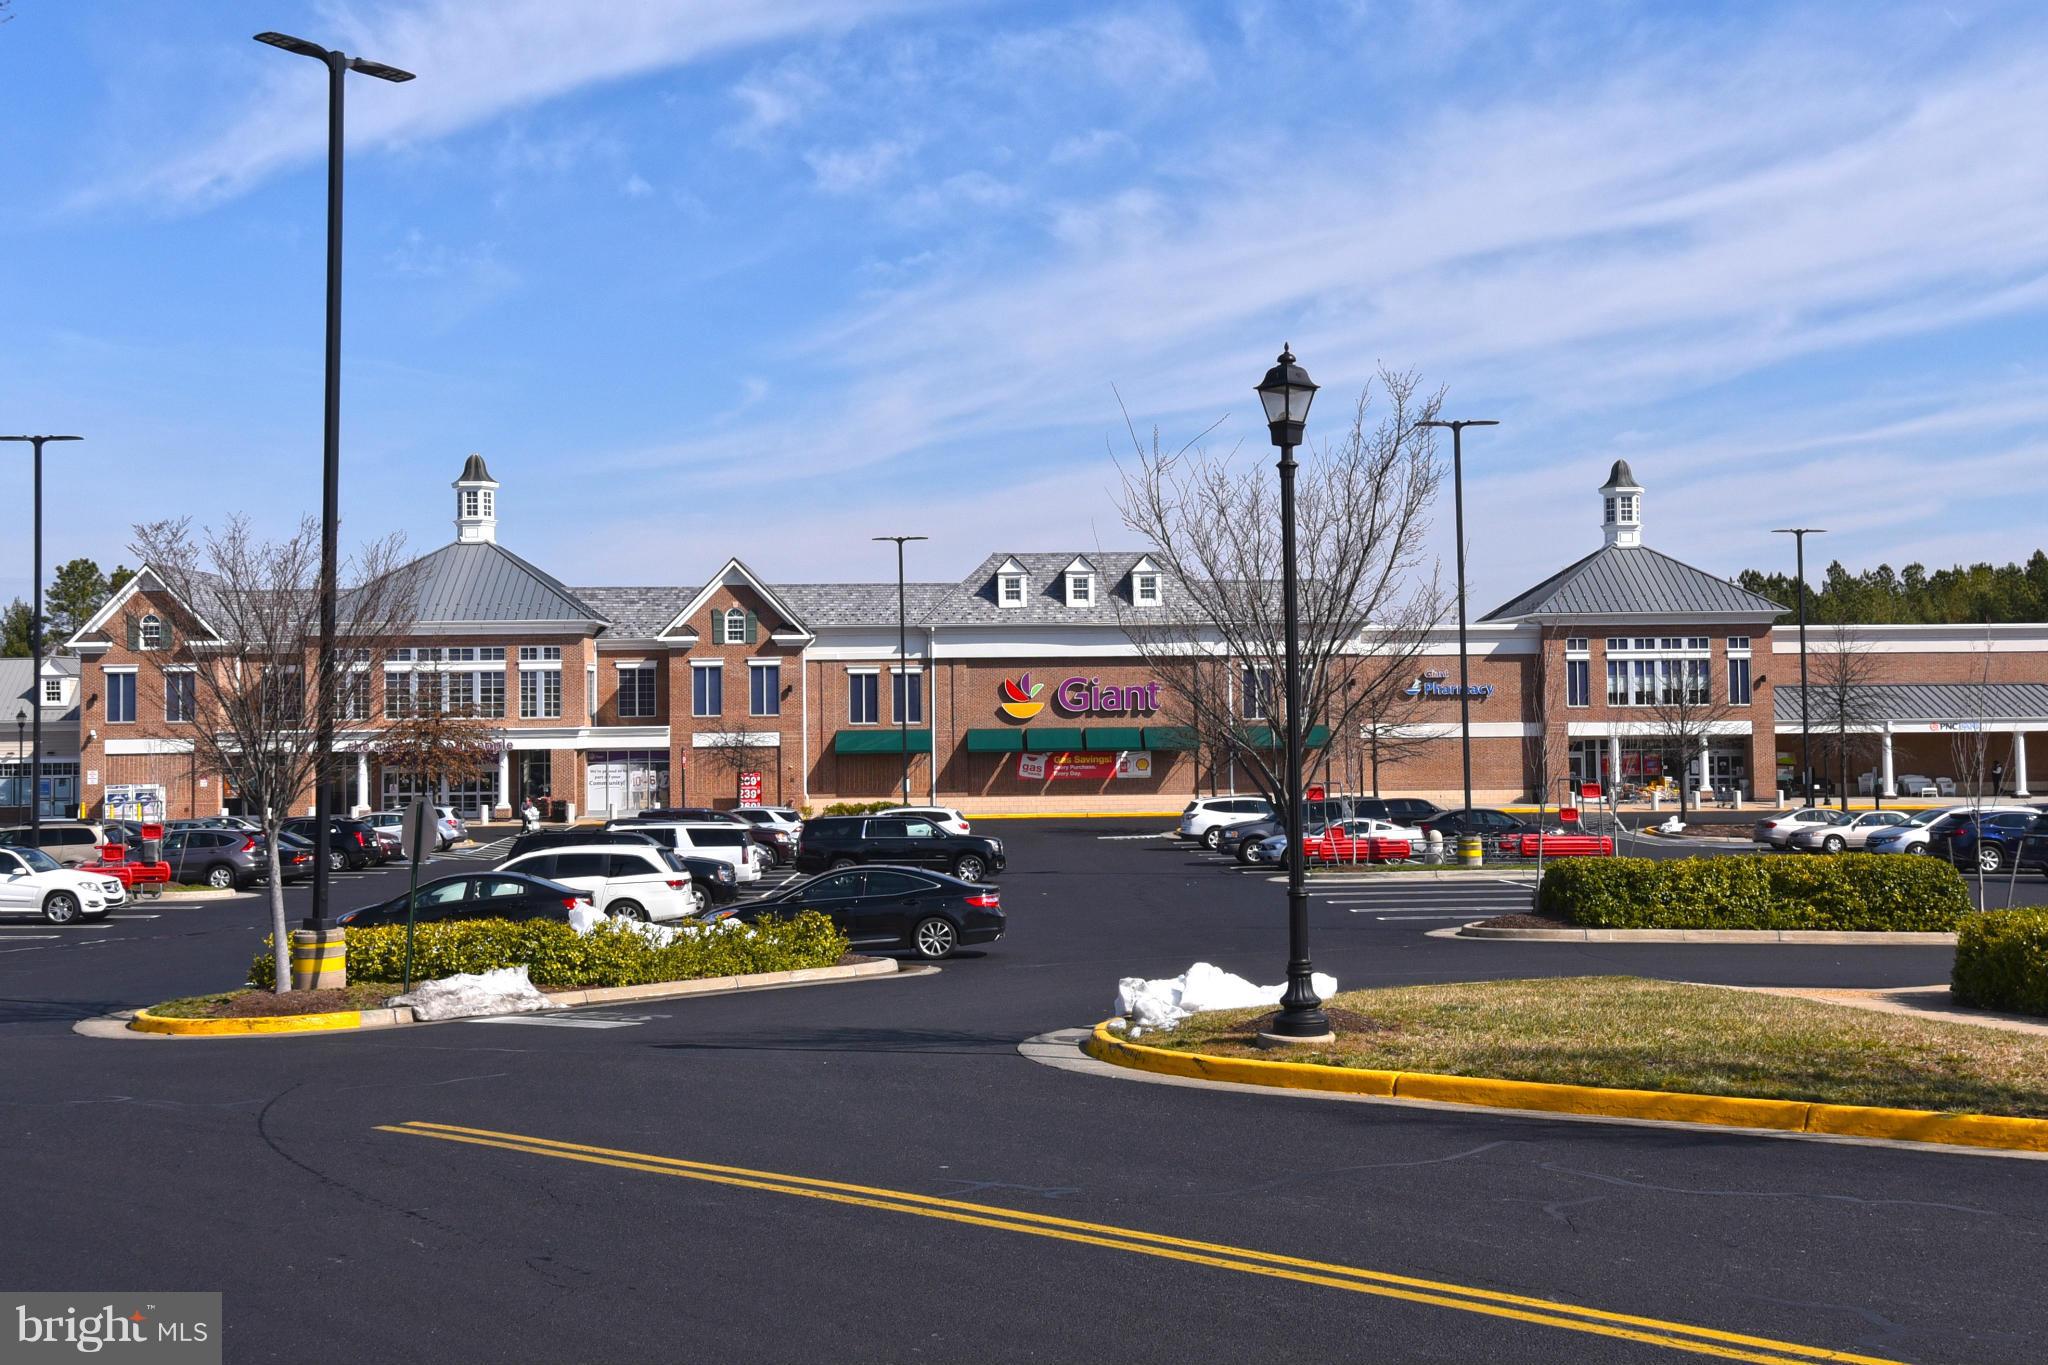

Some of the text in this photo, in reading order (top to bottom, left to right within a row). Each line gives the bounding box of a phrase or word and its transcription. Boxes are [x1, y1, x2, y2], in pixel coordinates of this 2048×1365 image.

[1057, 676, 1161, 712] Giant
[1940, 722, 1958, 730] PNC
[1023, 764, 1042, 773] gas
